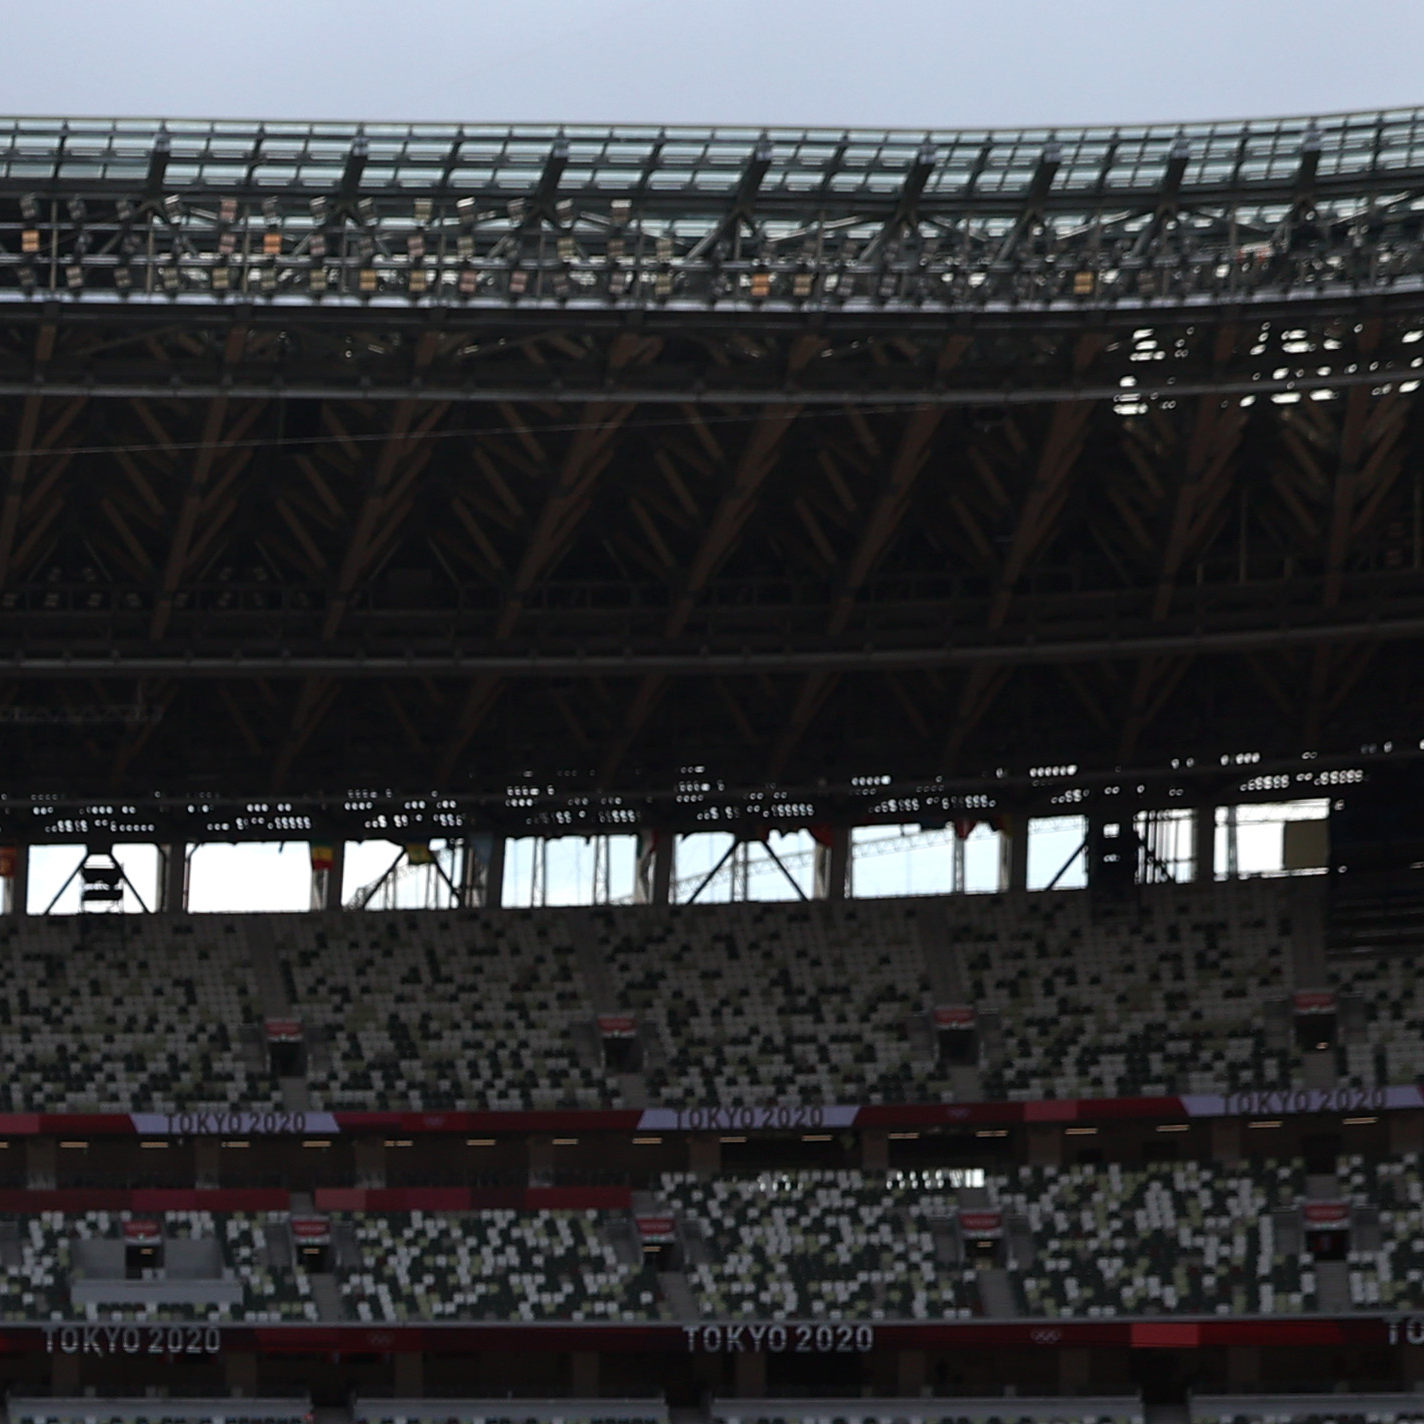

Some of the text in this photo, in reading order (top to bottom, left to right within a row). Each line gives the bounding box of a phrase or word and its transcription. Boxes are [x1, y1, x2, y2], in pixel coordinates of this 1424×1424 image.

[1220, 1086, 1386, 1118] TOKYO 2020
[163, 1112, 306, 1135] TOKYO 2020
[672, 1105, 823, 1131] TOKYO 2020
[42, 1326, 221, 1357] TOKYO 2020
[683, 1324, 874, 1353] TOKYO 2020
